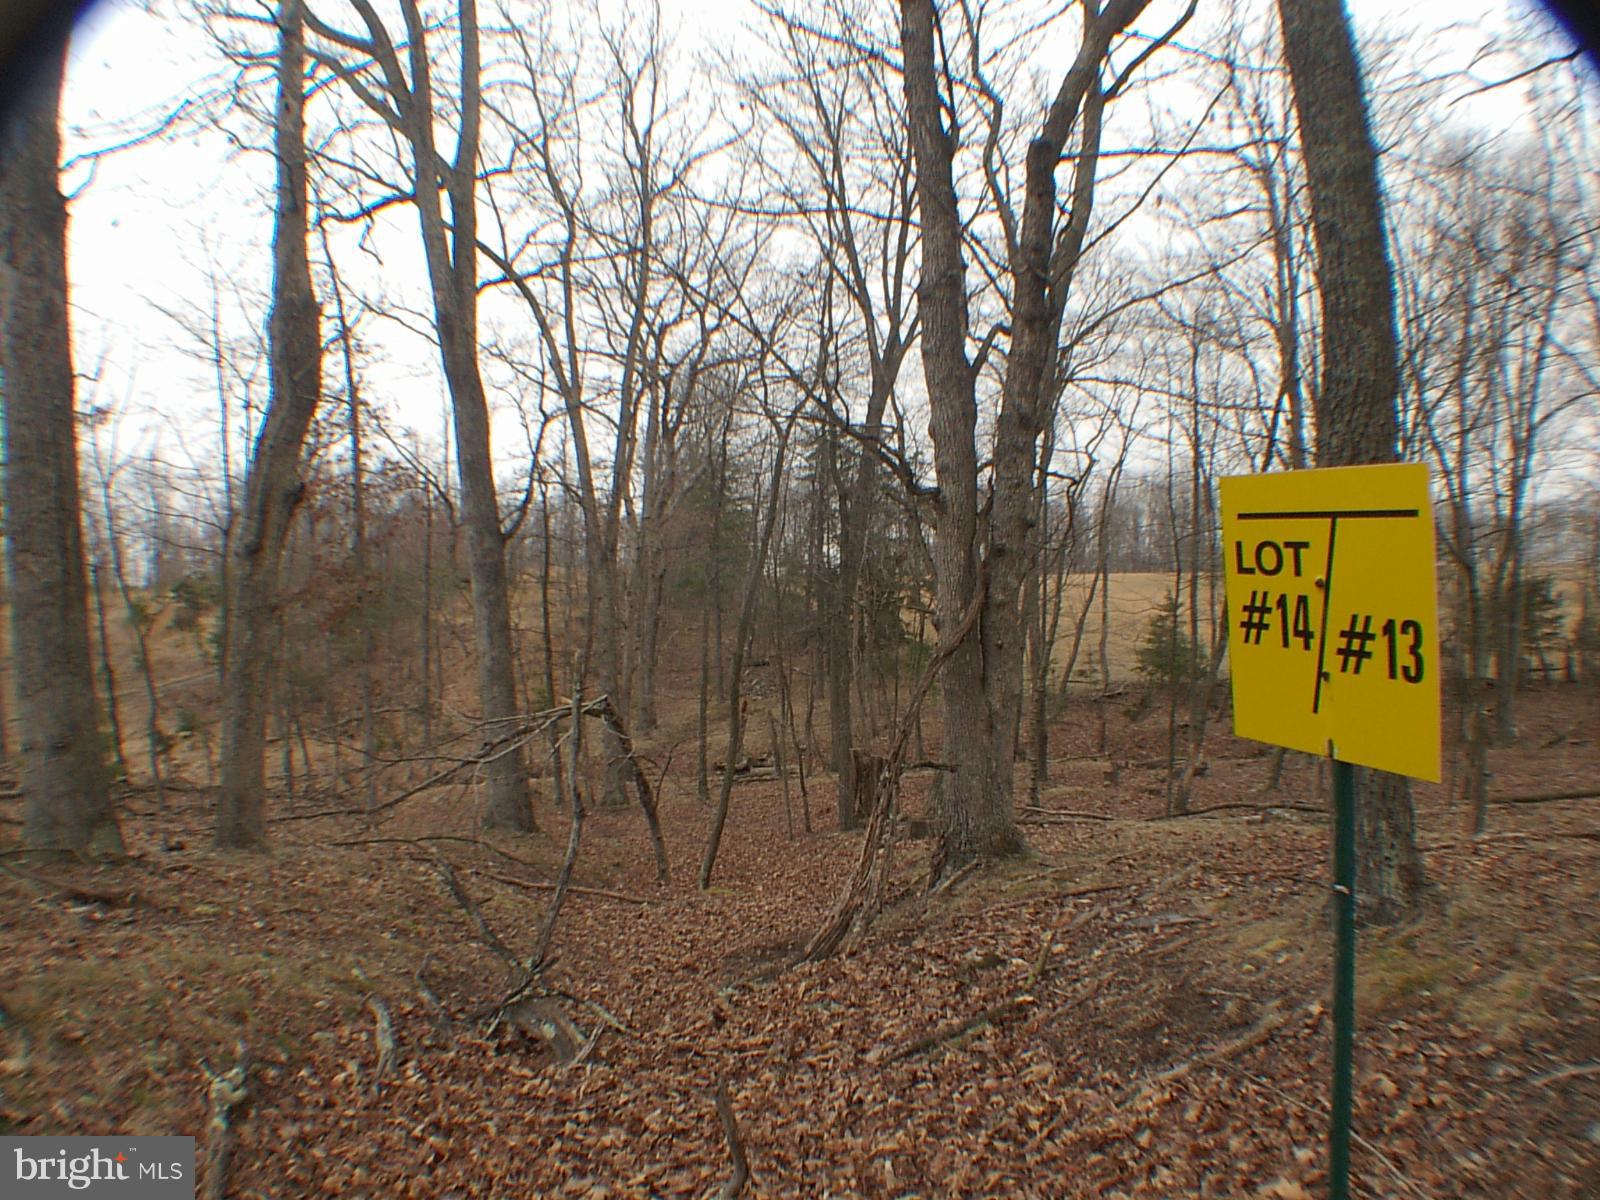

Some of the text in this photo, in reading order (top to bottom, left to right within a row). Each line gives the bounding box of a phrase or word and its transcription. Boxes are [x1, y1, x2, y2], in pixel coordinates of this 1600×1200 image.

[1235, 540, 1310, 577] LOT
[1239, 590, 1315, 651] #14
[1336, 613, 1425, 684] #13
